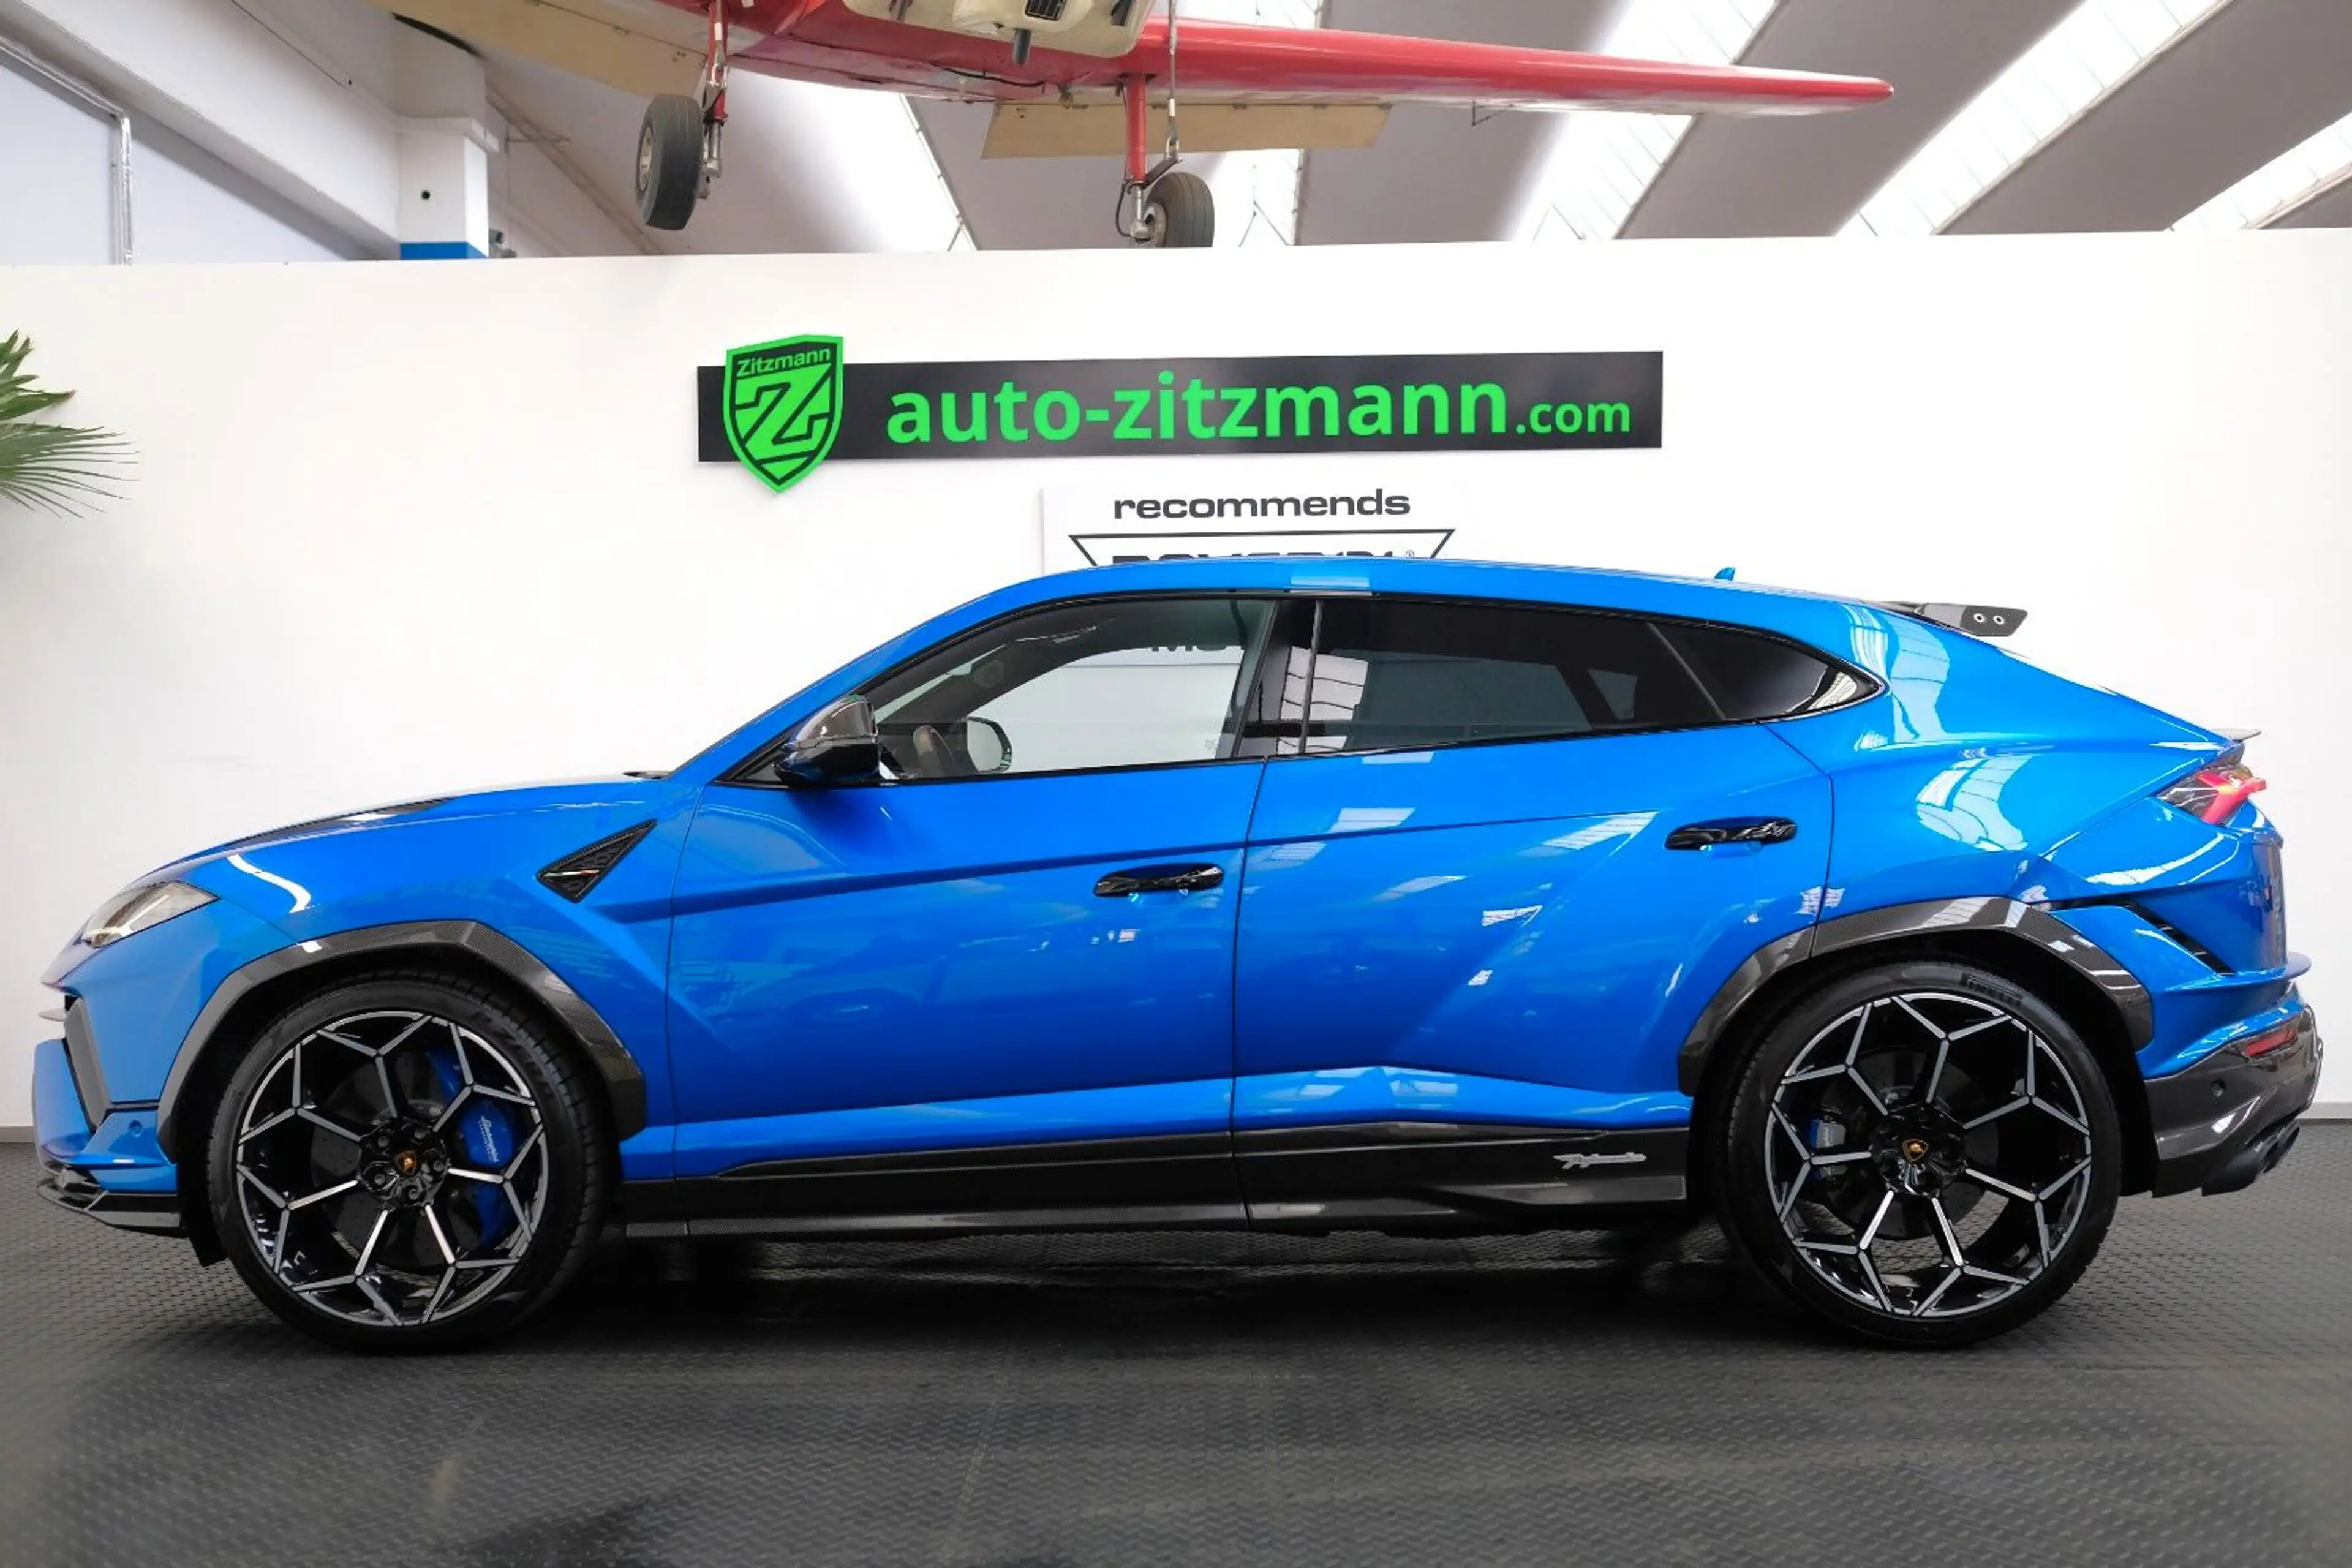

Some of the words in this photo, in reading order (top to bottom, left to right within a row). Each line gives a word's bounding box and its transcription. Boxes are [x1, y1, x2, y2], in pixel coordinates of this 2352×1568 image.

[737, 349, 831, 377] Zitzmann
[887, 371, 1630, 443] auto-zitzmann.com
[1114, 488, 1411, 519] recommends
